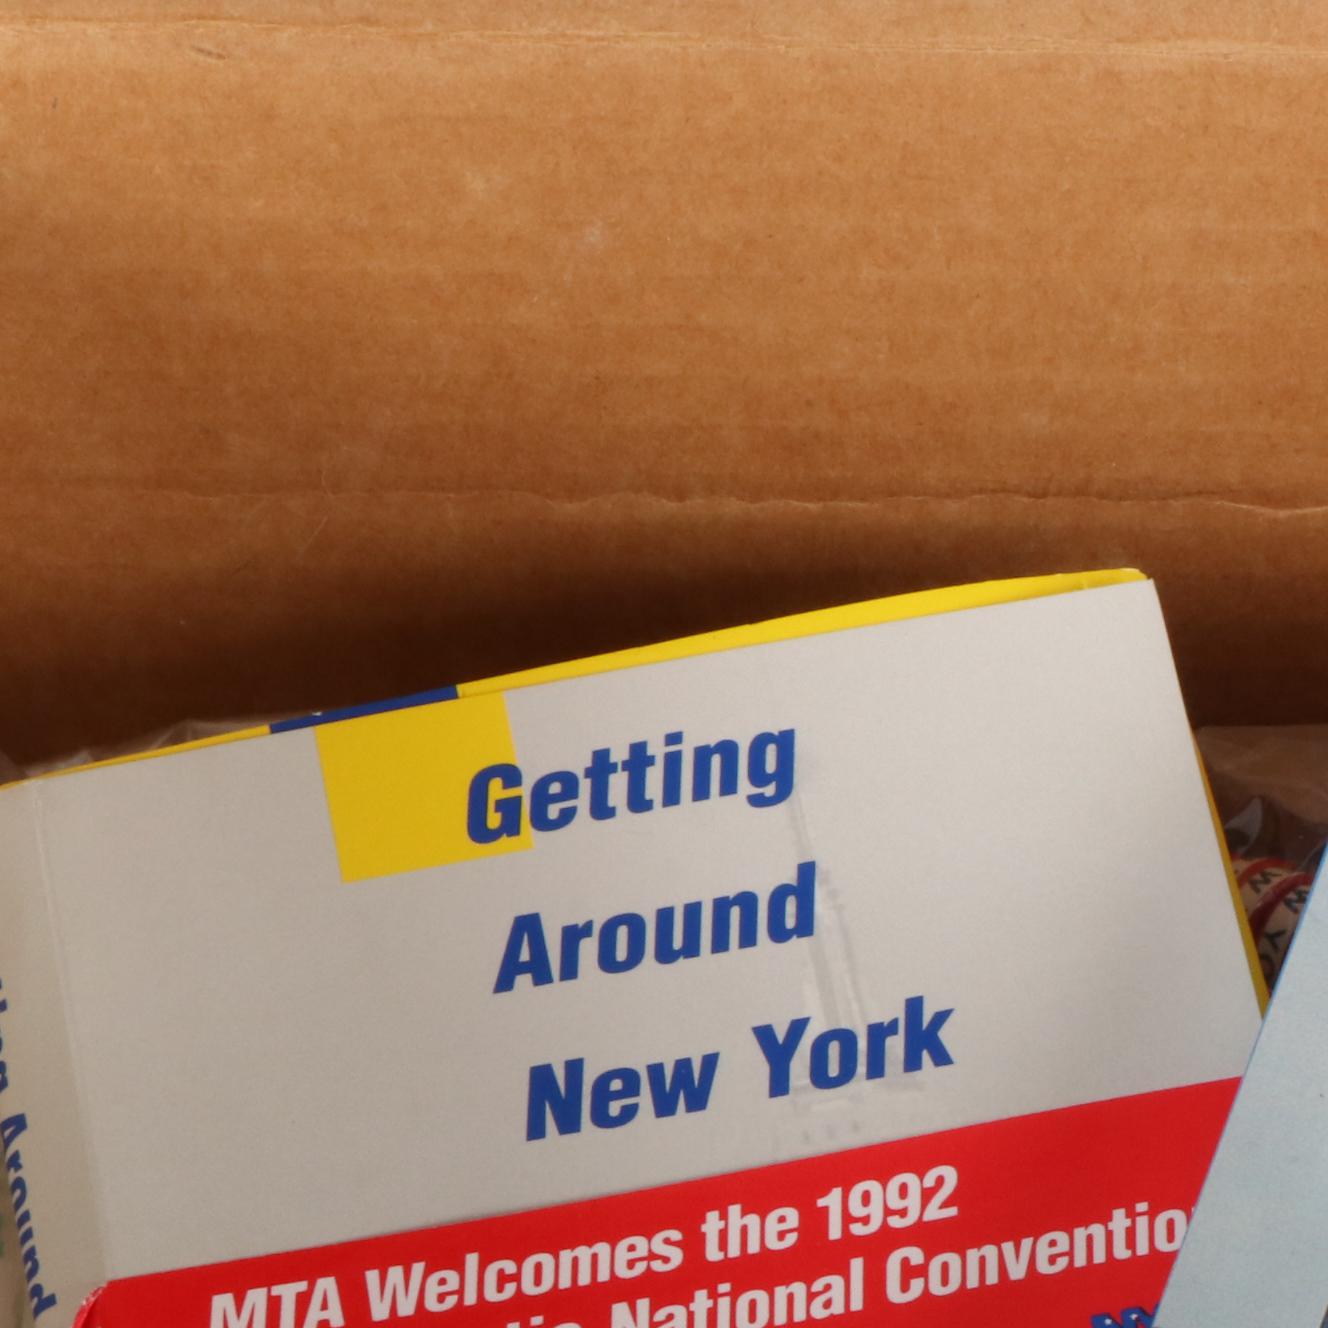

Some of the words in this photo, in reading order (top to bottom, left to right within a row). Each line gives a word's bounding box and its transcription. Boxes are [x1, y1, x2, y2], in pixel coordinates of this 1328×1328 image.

[465, 728, 796, 846] Getting
[492, 860, 817, 995] Around
[526, 1051, 720, 1142] New
[751, 995, 955, 1099] York
[364, 1226, 684, 1323] Welcomes
[700, 1203, 800, 1264] the
[816, 1165, 959, 1243] 1992
[885, 1201, 1194, 1305] Conventio
